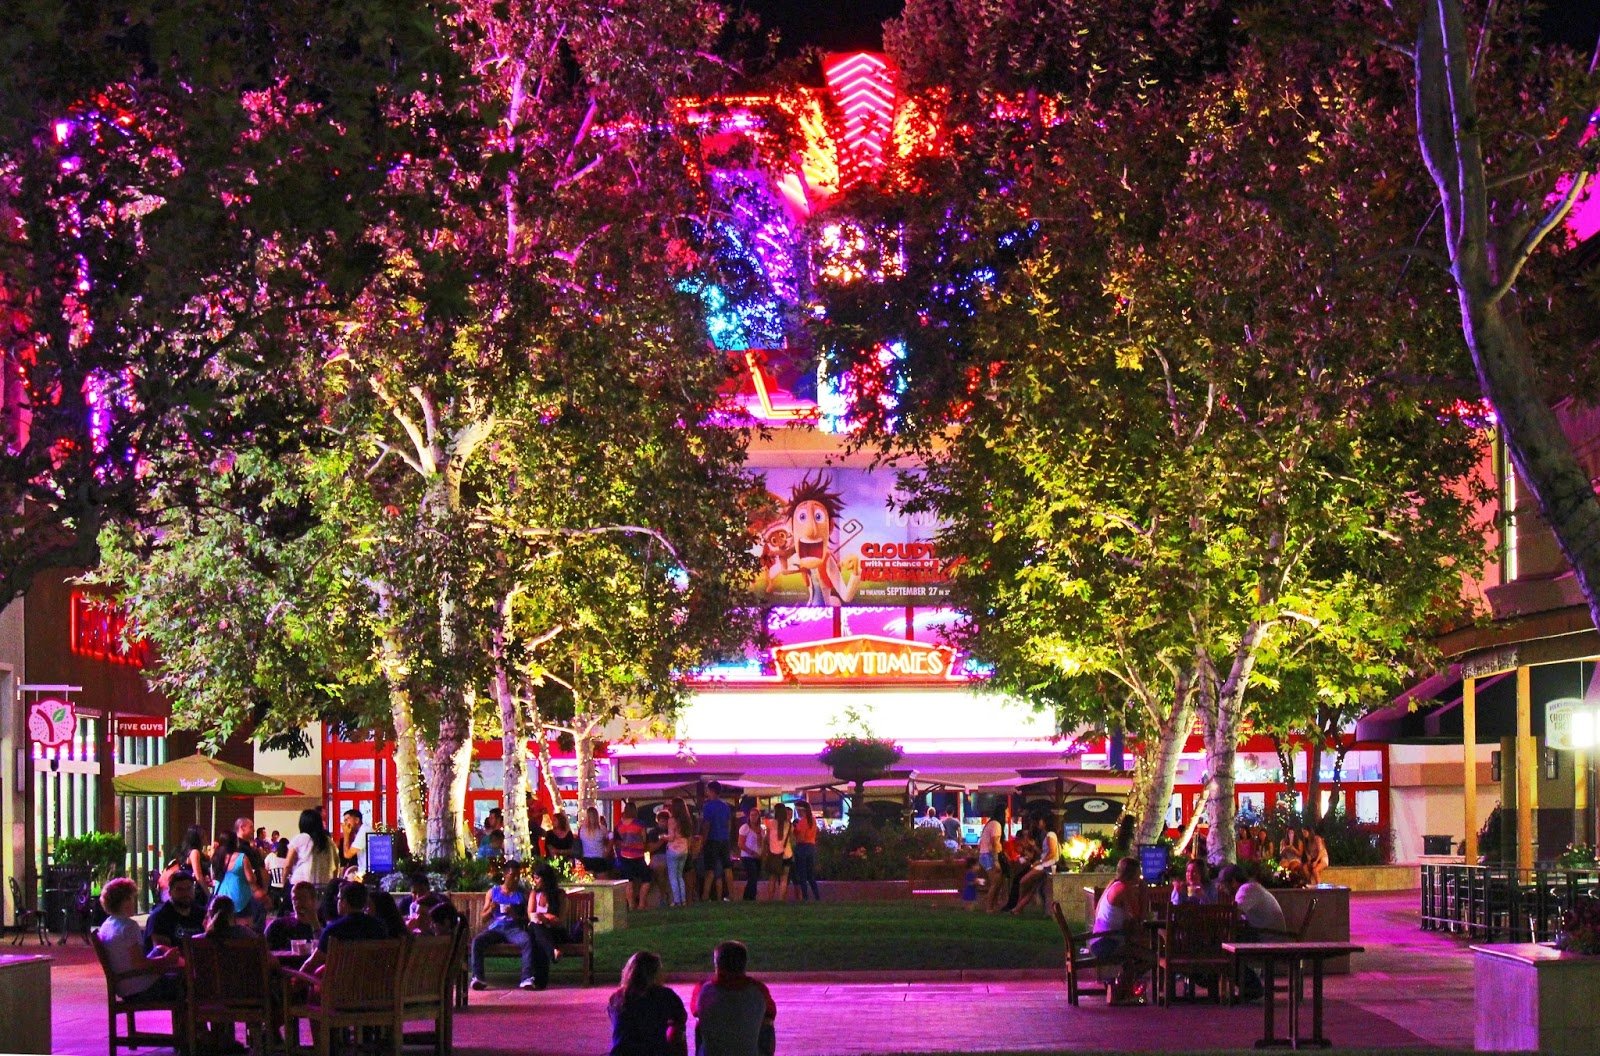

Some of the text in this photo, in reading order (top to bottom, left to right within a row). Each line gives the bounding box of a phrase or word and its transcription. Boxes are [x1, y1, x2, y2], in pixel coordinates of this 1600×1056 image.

[861, 543, 936, 559] CLOUDY
[865, 560, 883, 568] with
[892, 560, 922, 568] chance
[924, 560, 934, 568] of
[887, 586, 926, 596] SEPTEMBER
[929, 586, 938, 596] 27
[785, 650, 945, 676] SHOWTIMES
[119, 723, 163, 731] FIVE GUYS
